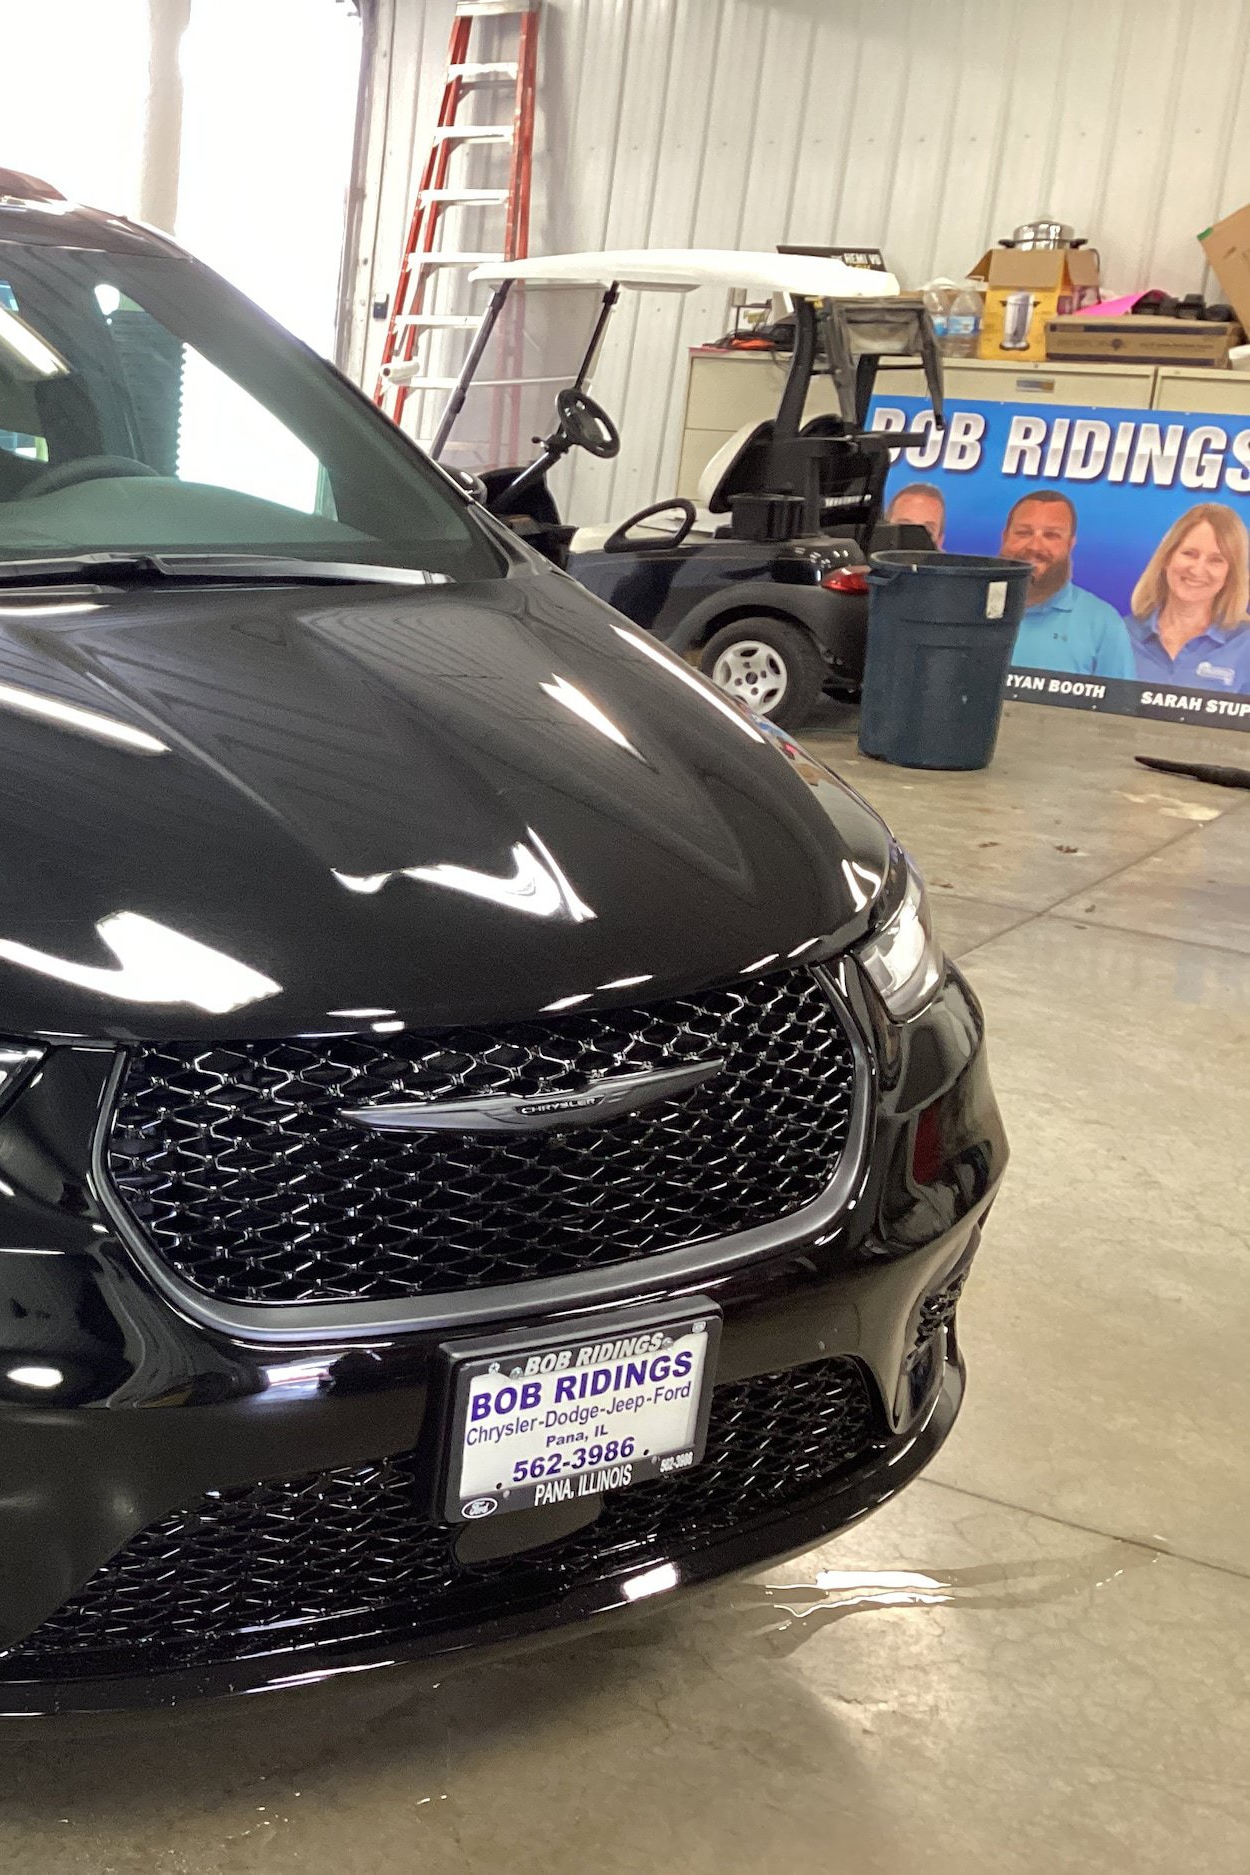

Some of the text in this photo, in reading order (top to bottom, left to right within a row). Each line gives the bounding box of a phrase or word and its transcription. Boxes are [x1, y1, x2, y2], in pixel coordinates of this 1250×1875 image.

[872, 408, 1250, 492] BOB RIDINGS
[1048, 680, 1106, 699] BOOTH
[1141, 691, 1203, 711] SARAH
[521, 1098, 595, 1113] CHRYSLER
[525, 1332, 664, 1376] BOB RIDINGS
[471, 1351, 693, 1421] BOB RIDINGS
[466, 1381, 691, 1446] Chrysler-Dodge-Jeep-Ford
[546, 1424, 609, 1448] Pana, IL
[513, 1436, 635, 1482] 562-3986
[578, 1464, 632, 1496] ILLINOIS
